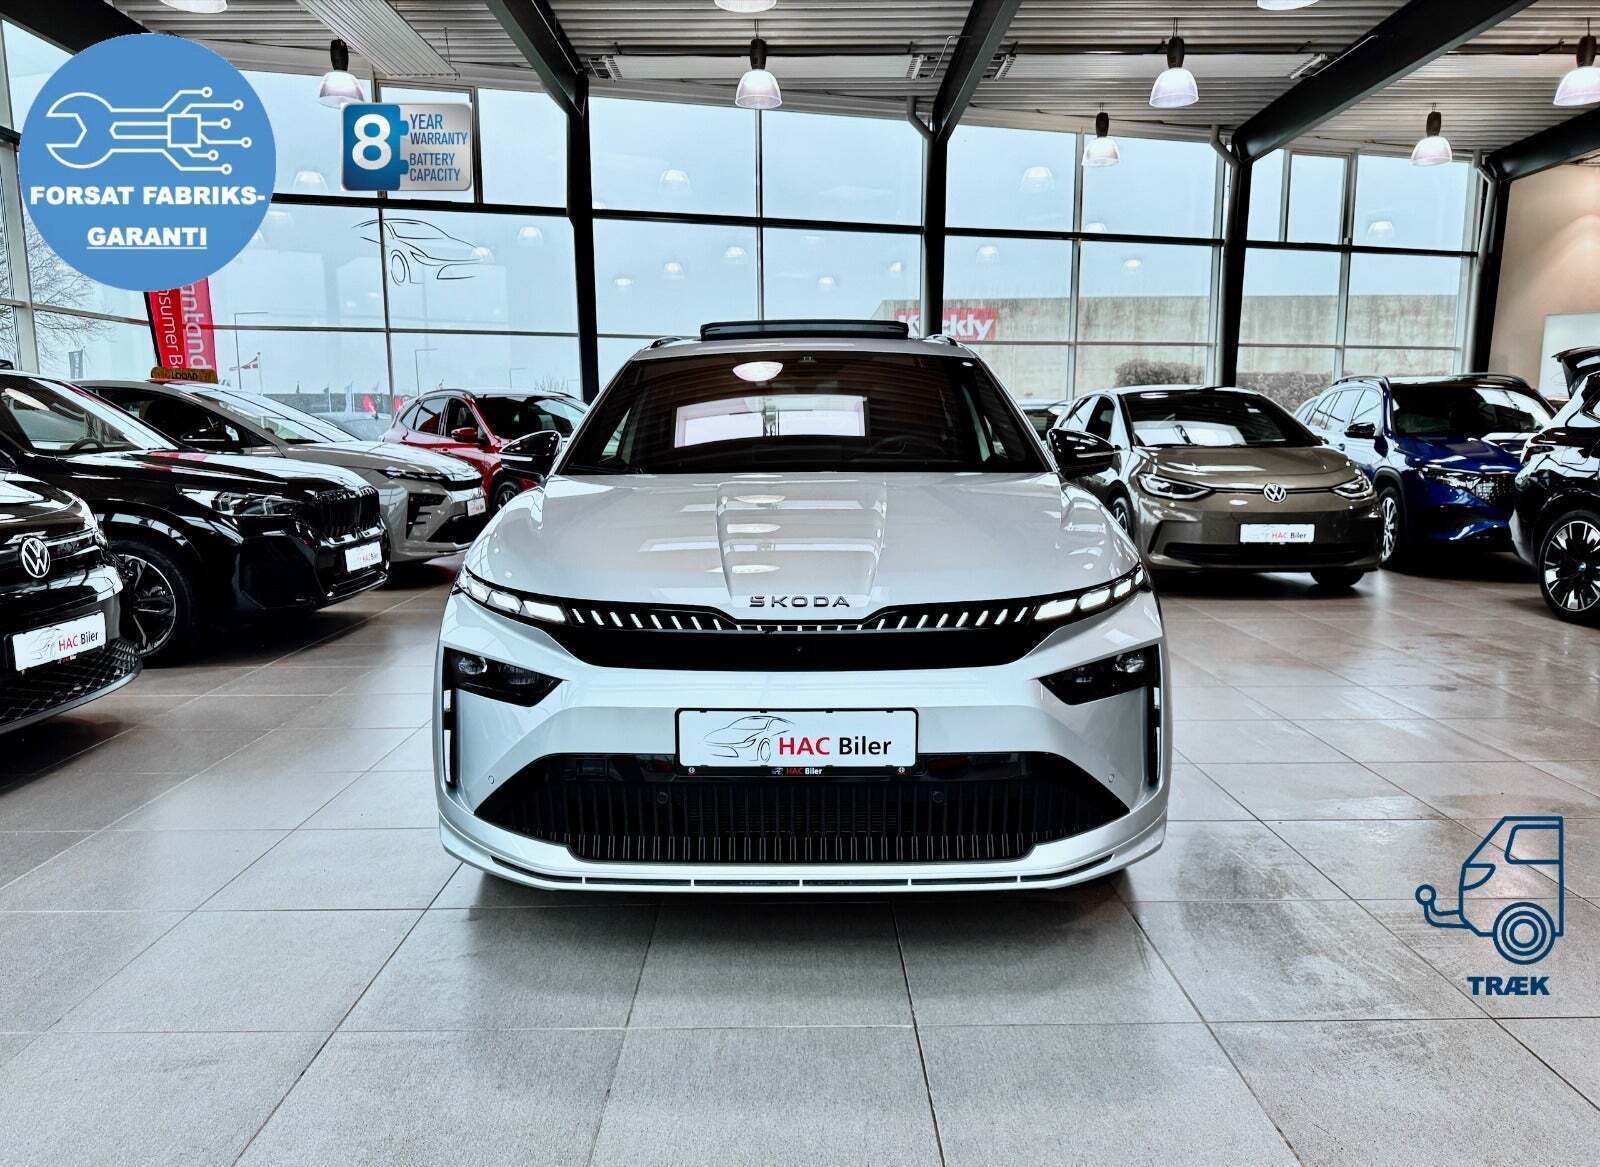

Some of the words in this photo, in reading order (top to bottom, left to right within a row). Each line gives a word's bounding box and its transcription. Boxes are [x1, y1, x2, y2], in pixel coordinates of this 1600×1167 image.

[58, 635, 79, 652] HAC
[779, 736, 831, 756] HAC
[839, 735, 892, 756] Biler
[804, 767, 823, 775] Biler
